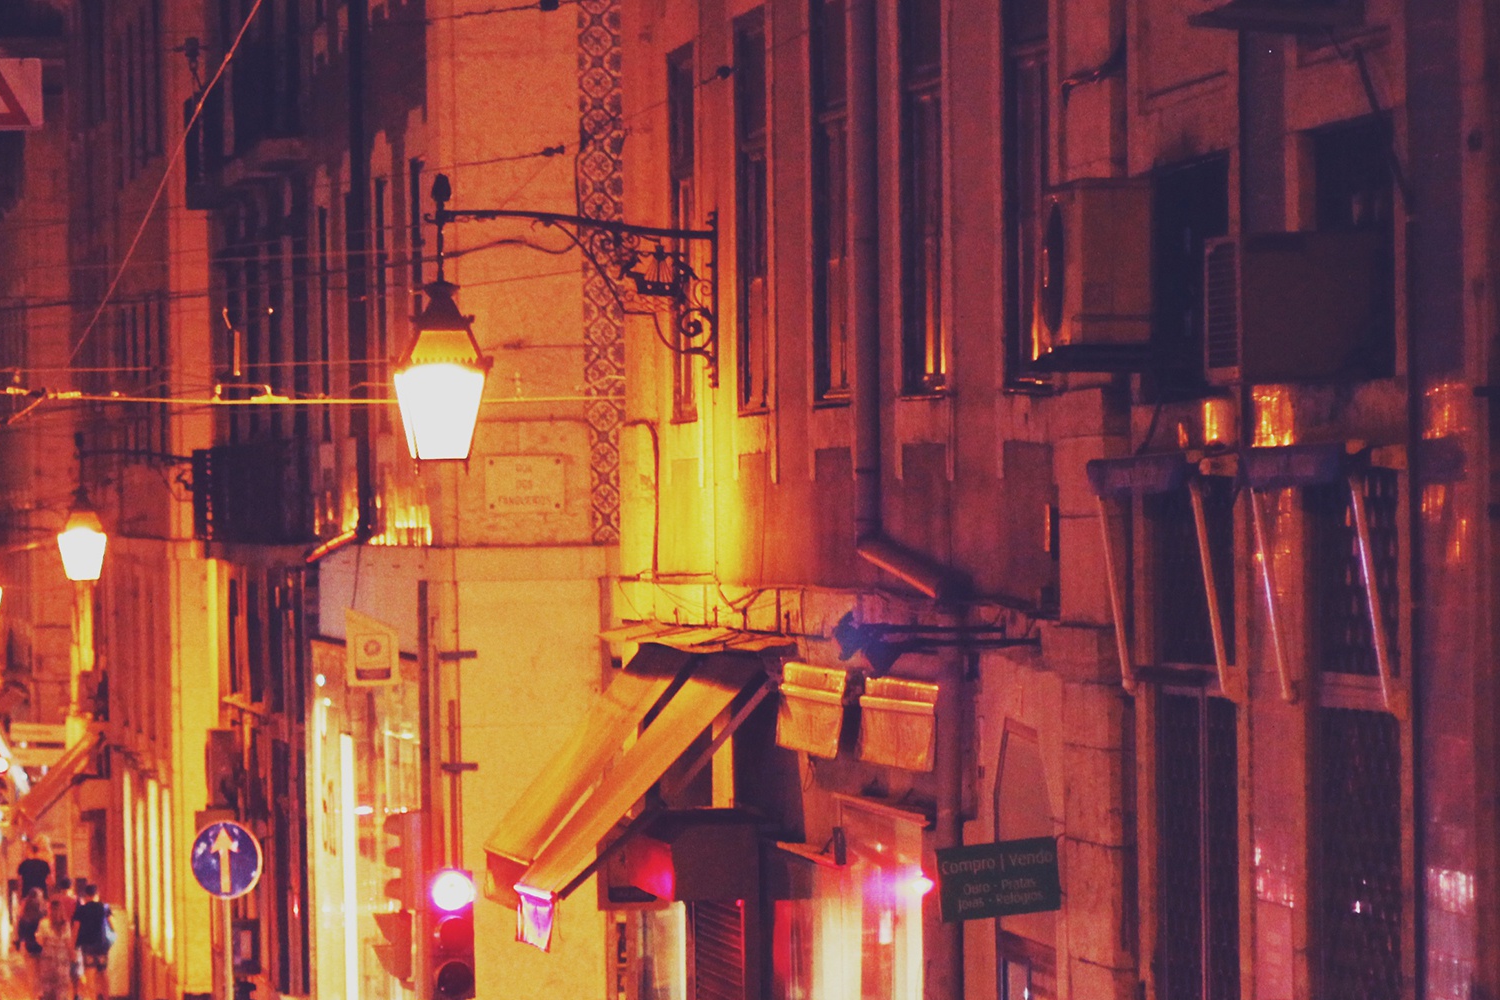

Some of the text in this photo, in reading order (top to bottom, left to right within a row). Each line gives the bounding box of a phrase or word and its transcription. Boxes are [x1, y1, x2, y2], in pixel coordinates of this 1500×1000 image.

[941, 858, 996, 876] Compro
[1008, 849, 1054, 867] Vendo
[962, 882, 991, 896] Ouro
